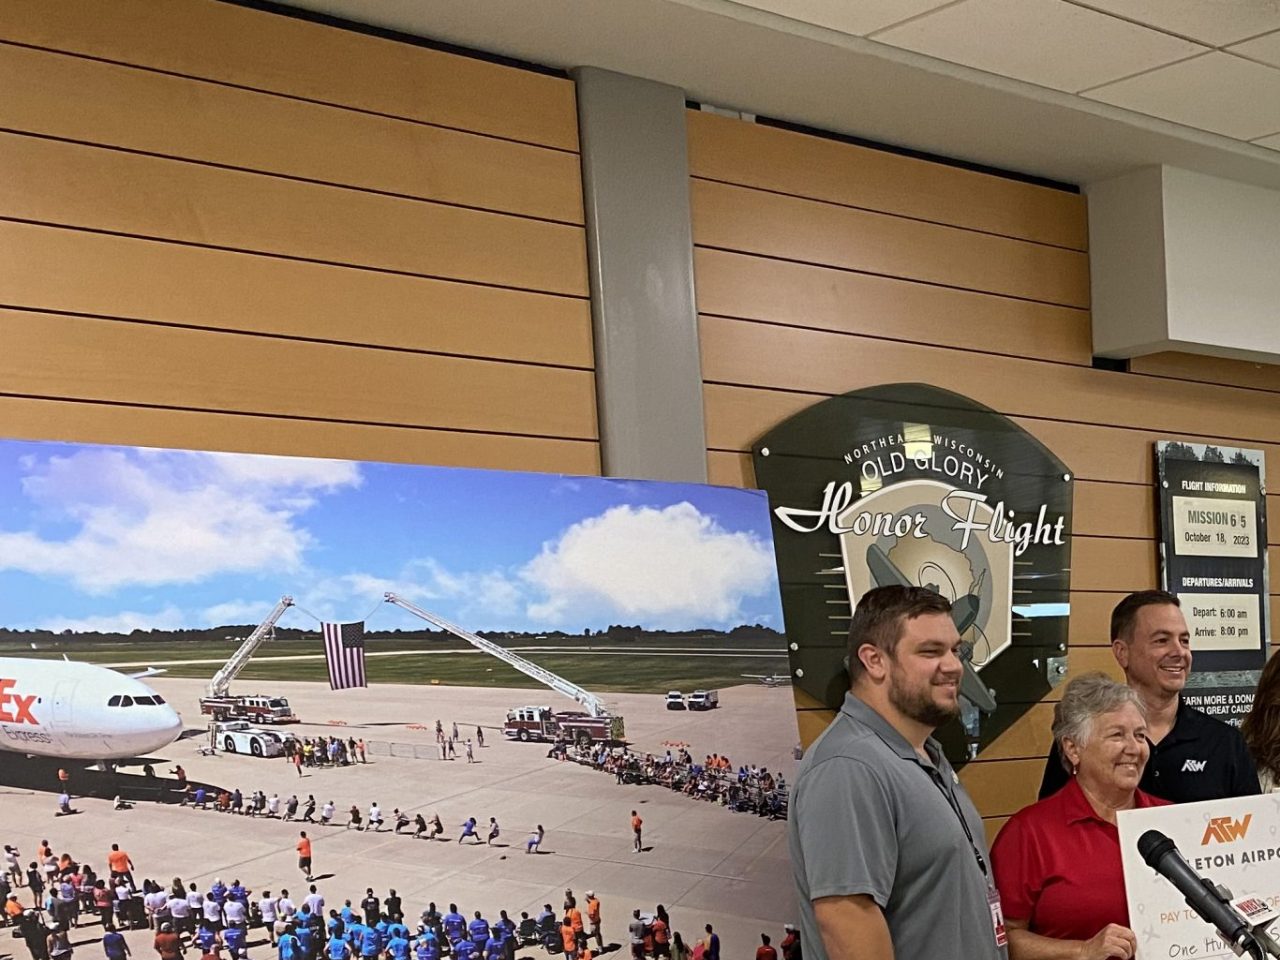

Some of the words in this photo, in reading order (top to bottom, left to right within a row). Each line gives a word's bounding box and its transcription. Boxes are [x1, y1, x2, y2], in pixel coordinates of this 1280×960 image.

[844, 434, 904, 465] NORTHEA
[933, 435, 1004, 479] WISCONSIN
[862, 451, 905, 481] OLD
[914, 450, 989, 489] GLORY
[1182, 480, 1203, 491] FLIGHT
[1205, 482, 1246, 494] INFORMATION
[774, 482, 930, 538] Honor
[941, 490, 1065, 557] Flight
[1188, 510, 1229, 525] MISSION
[1185, 531, 1211, 543] October
[1216, 533, 1226, 544] 18,
[1233, 535, 1250, 546] 2023
[1182, 577, 1254, 588] DEPARTURES/ARRIVALS
[1193, 607, 1217, 618] Depart:
[1220, 609, 1235, 618] 6:00
[1237, 610, 1247, 618] am
[1195, 627, 1217, 637] Arrive:
[1220, 626, 1236, 636] 8:00
[1238, 628, 1248, 637] pm
[1183, 696, 1202, 705] ARN
[1204, 695, 1227, 705] MORE
[1229, 695, 1234, 704] &
[1206, 706, 1229, 715] GREAT
[1201, 814, 1252, 846] ATW
[1160, 911, 1180, 924] PAY
[1183, 909, 1199, 920] TO
[1168, 943, 1198, 958] One
